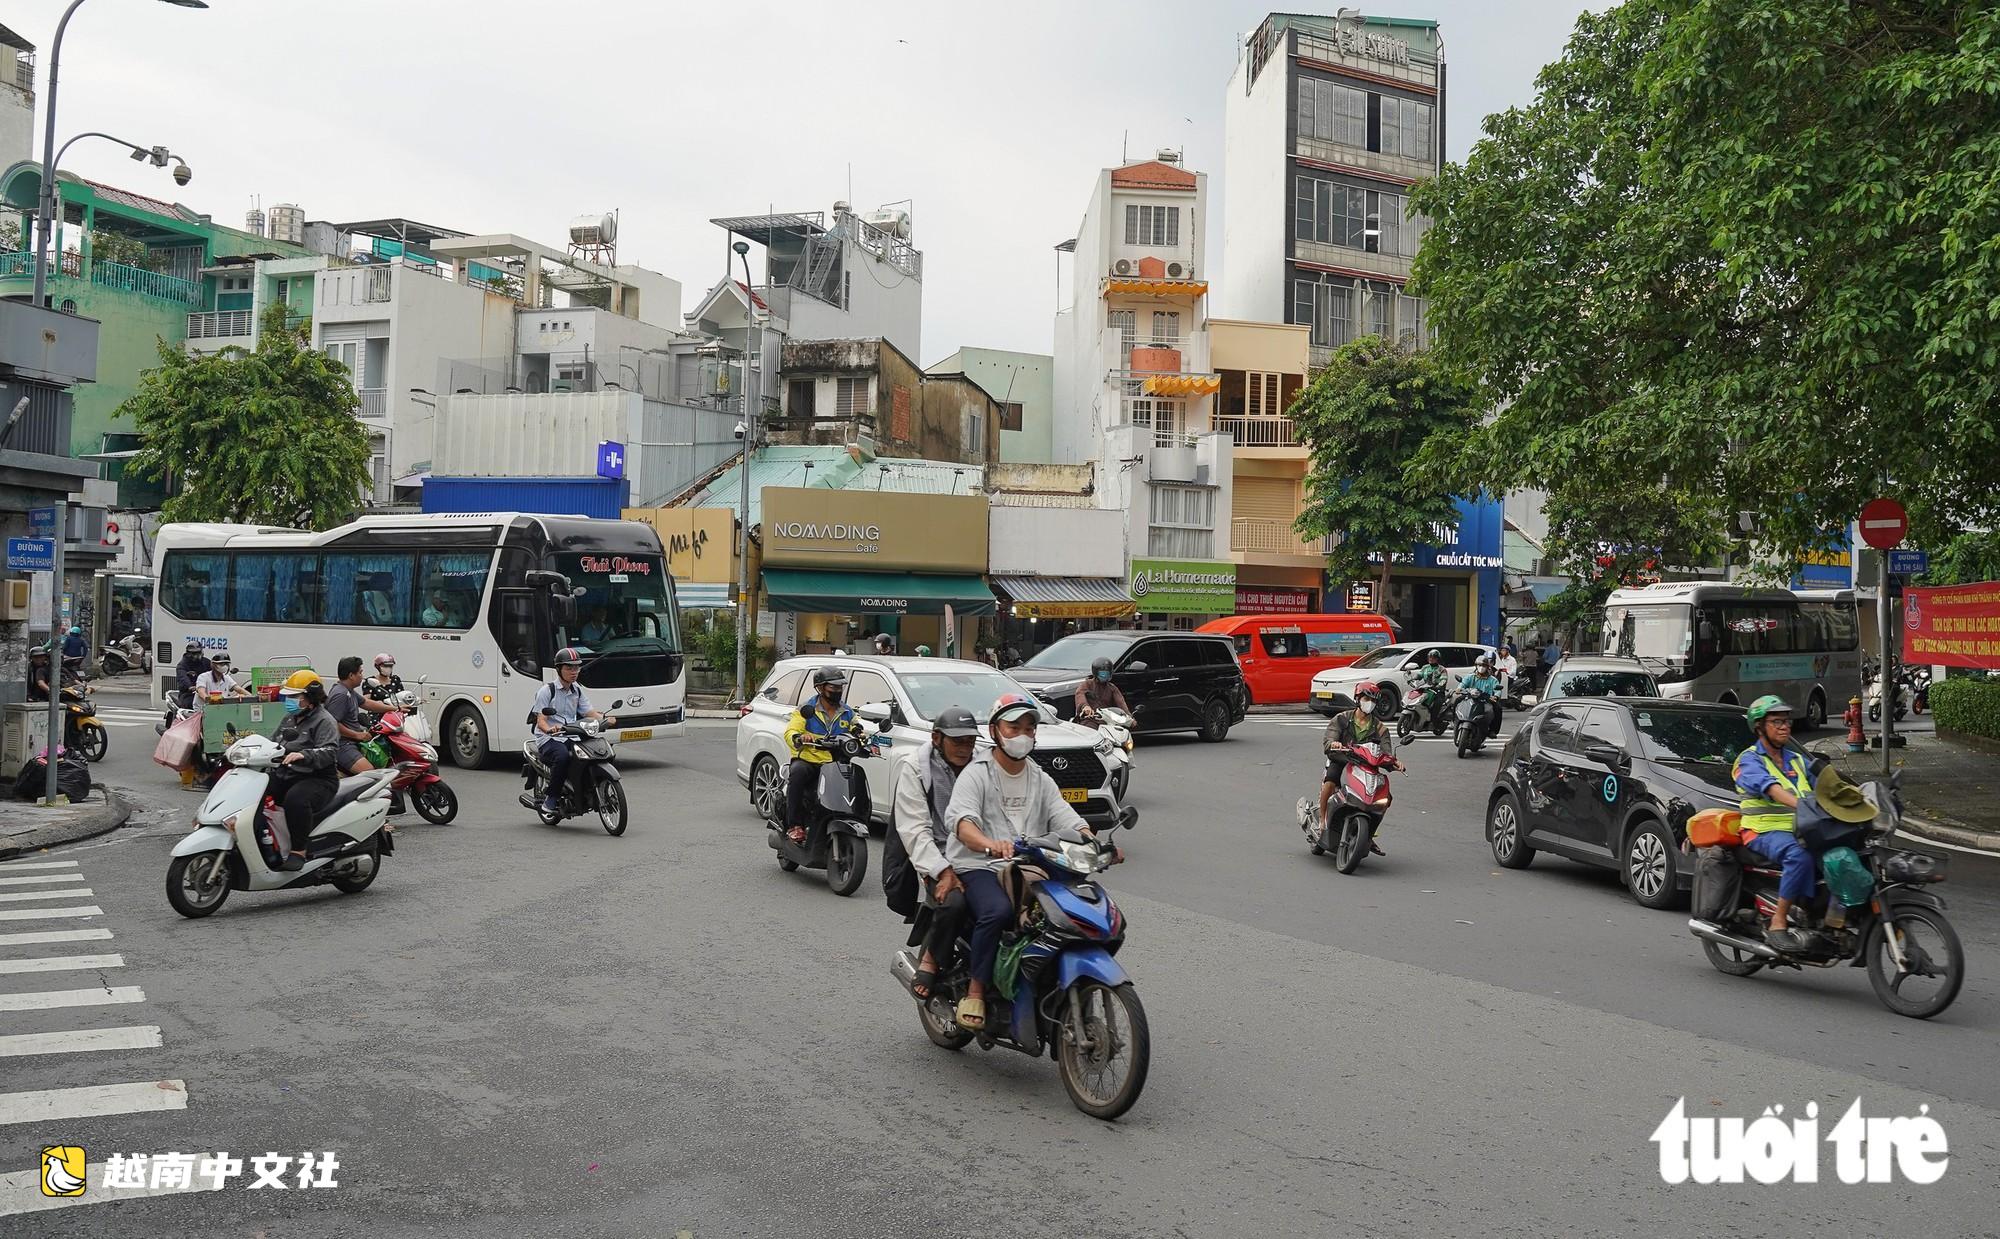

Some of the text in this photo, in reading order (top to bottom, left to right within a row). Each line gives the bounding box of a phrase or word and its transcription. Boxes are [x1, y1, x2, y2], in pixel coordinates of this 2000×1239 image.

[773, 522, 880, 540] NOMADING
[17, 542, 44, 552] ĐƯỜNG
[856, 543, 879, 553] Café
[580, 556, 650, 576] Thái Phong
[1436, 551, 1503, 568] CHUỖI CẮT TÓC NAM
[1164, 569, 1236, 585] Homemade
[860, 599, 908, 608] NOMADING
[1247, 594, 1259, 604] CHO
[1260, 593, 1273, 605] THUÊ
[1274, 594, 1296, 606] NGUYÊN
[1953, 617, 1967, 632] THAM
[1967, 617, 1976, 632] GIA
[1976, 614, 1987, 632] CÁC
